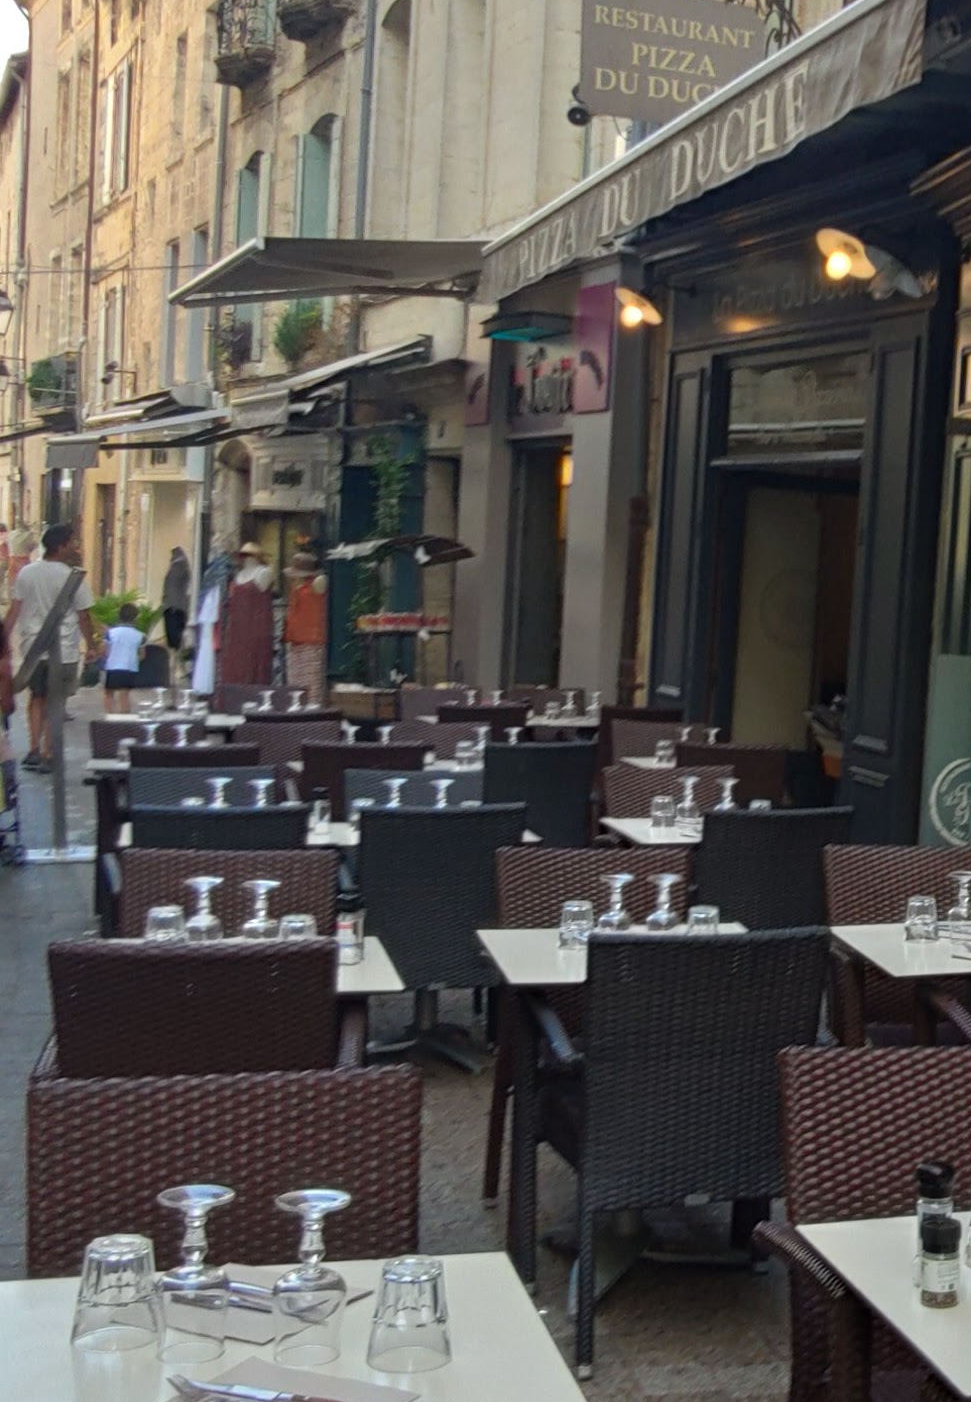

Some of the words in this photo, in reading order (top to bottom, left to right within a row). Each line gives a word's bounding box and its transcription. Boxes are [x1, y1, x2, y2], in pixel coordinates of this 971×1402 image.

[593, 3, 756, 49] RESTAURANT
[631, 42, 716, 78] PIZZA
[594, 67, 639, 95] DU
[648, 75, 720, 104] DUC
[517, 211, 578, 279] PIZZA
[598, 168, 642, 238] DU
[669, 58, 810, 201] DUCHE
